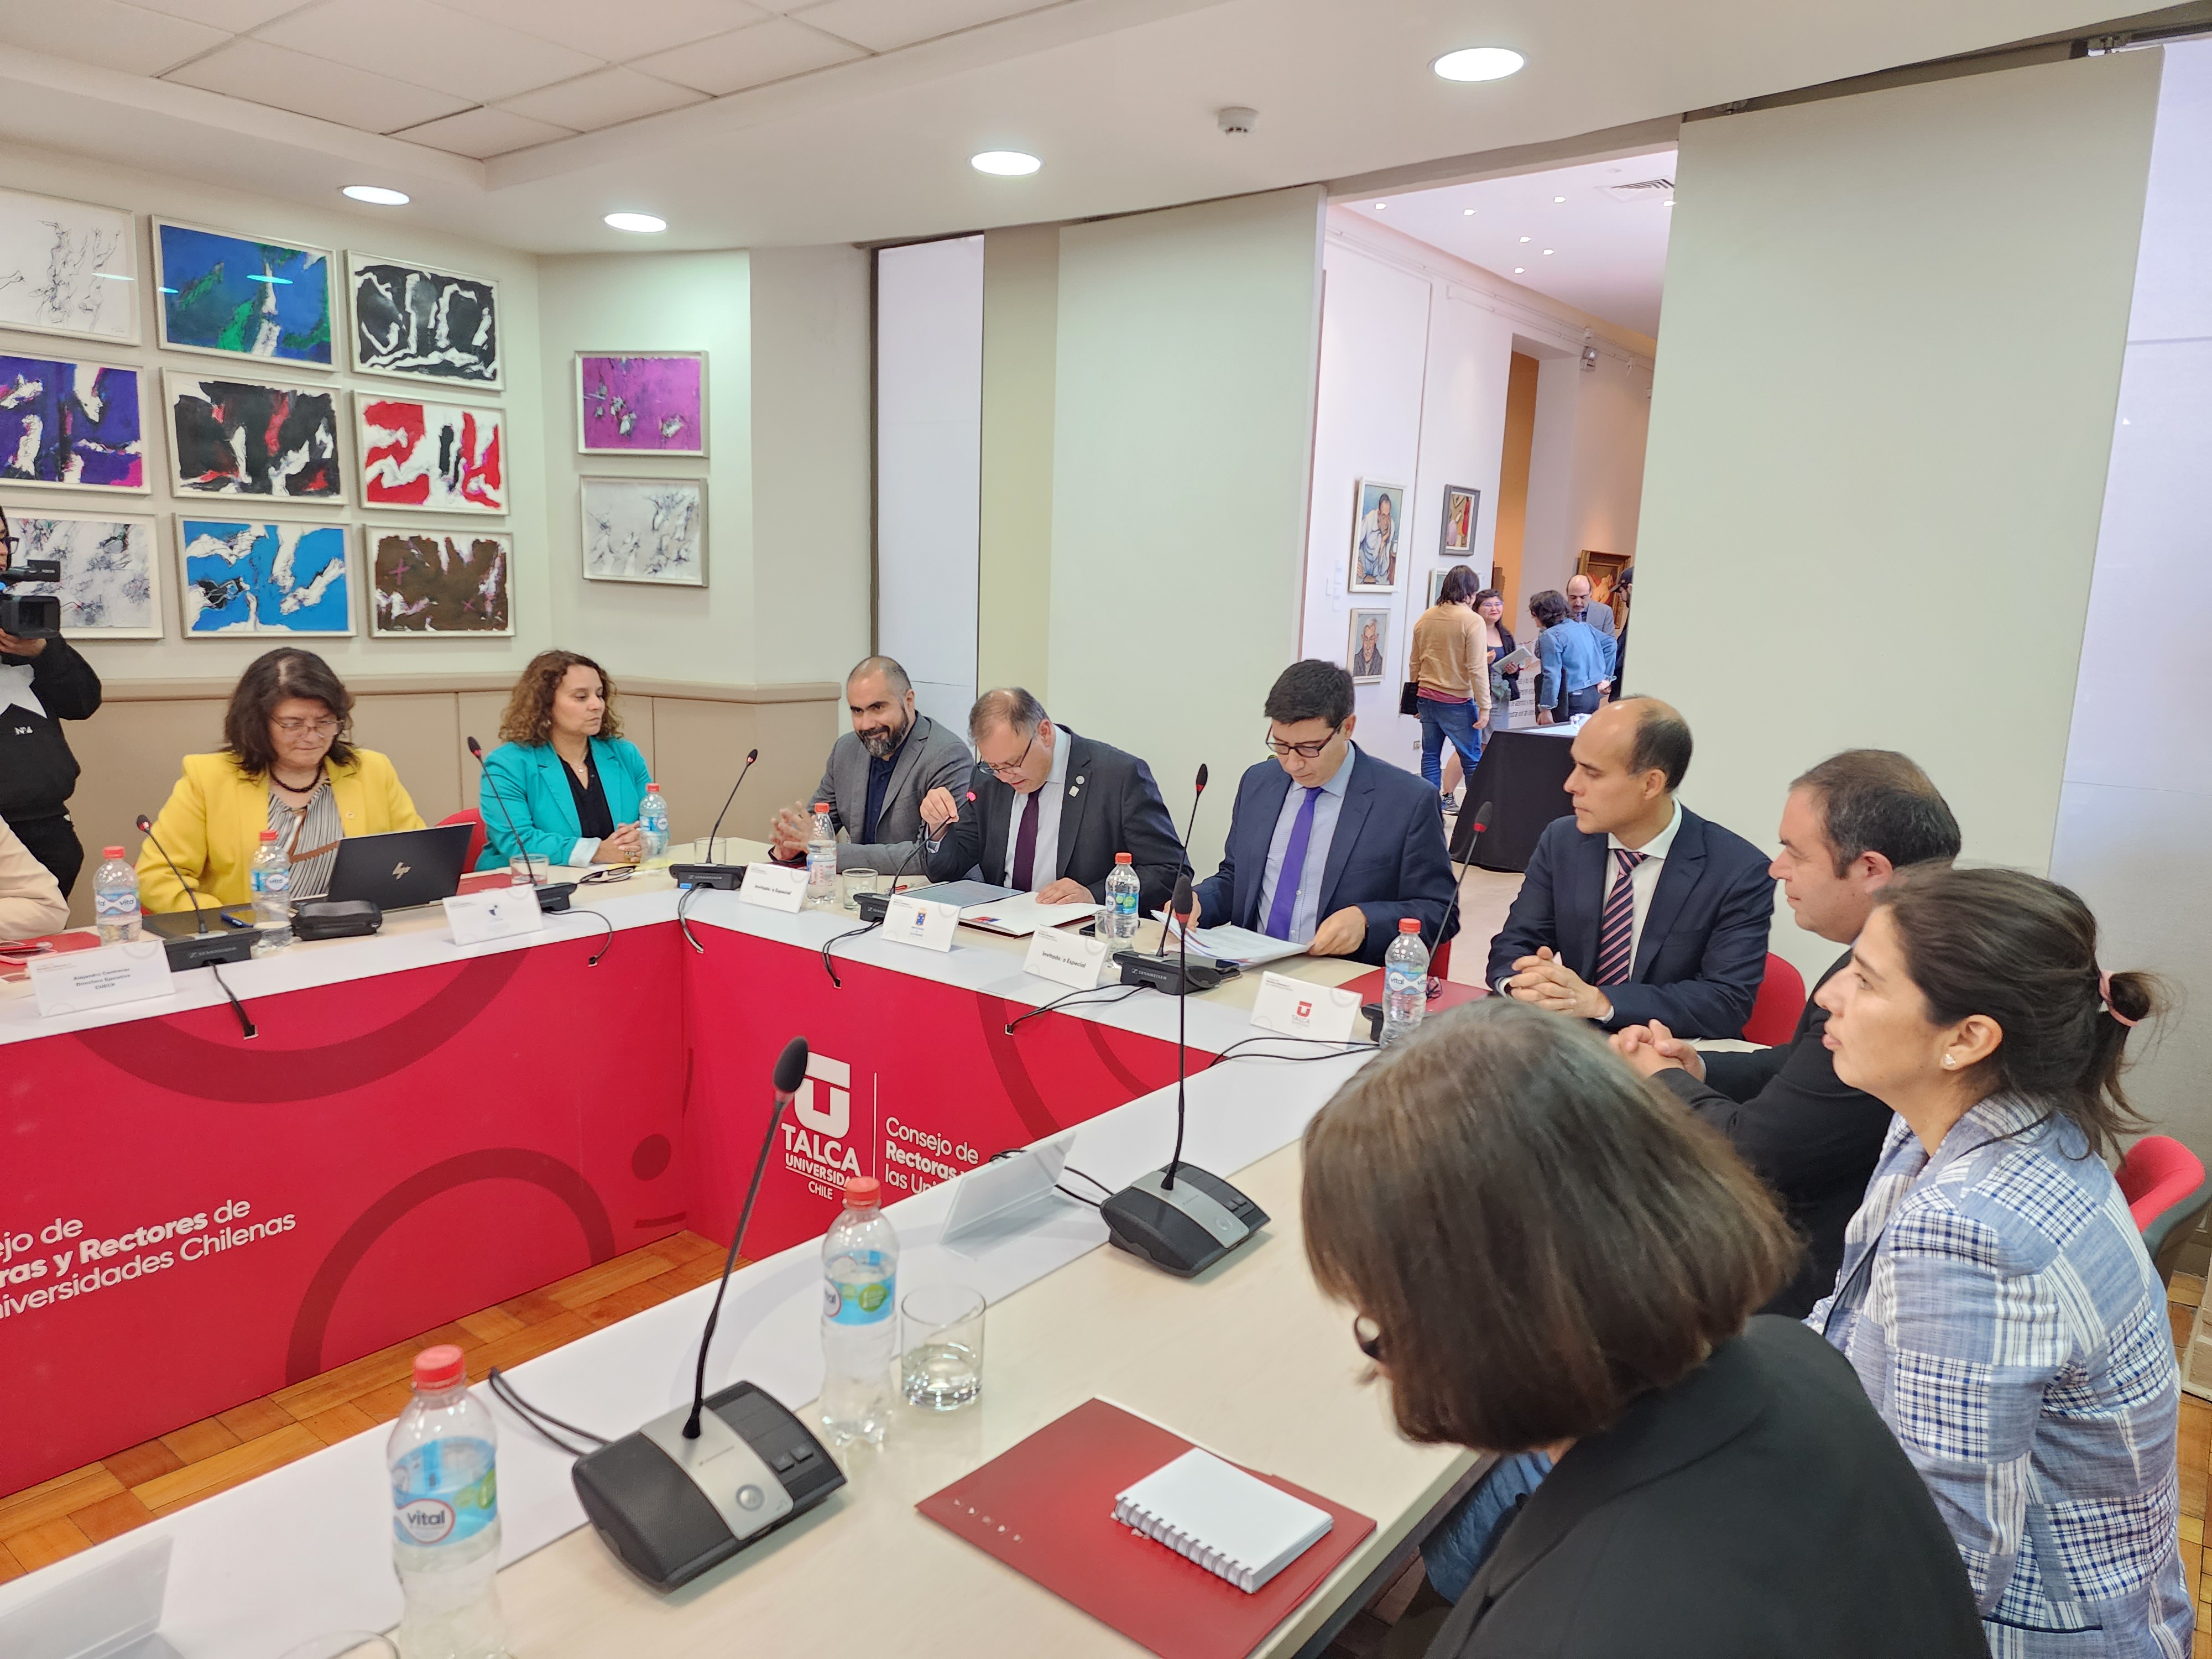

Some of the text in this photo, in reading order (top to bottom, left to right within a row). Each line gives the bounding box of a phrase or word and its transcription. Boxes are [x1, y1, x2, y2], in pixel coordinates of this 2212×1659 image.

[1067, 958, 1087, 968] Especial
[781, 1123, 862, 1177] TALCA
[886, 1117, 979, 1165] Consejo de
[885, 1163, 908, 1190] las
[886, 1140, 957, 1180] Rectoras
[808, 1181, 833, 1201] CHILE
[40, 1218, 84, 1244] de
[53, 1250, 74, 1277] y
[79, 1213, 208, 1264] Rectores
[213, 1199, 251, 1224] de
[0, 1214, 296, 1319] iversidades Chilenas
[407, 1509, 446, 1526] vital
